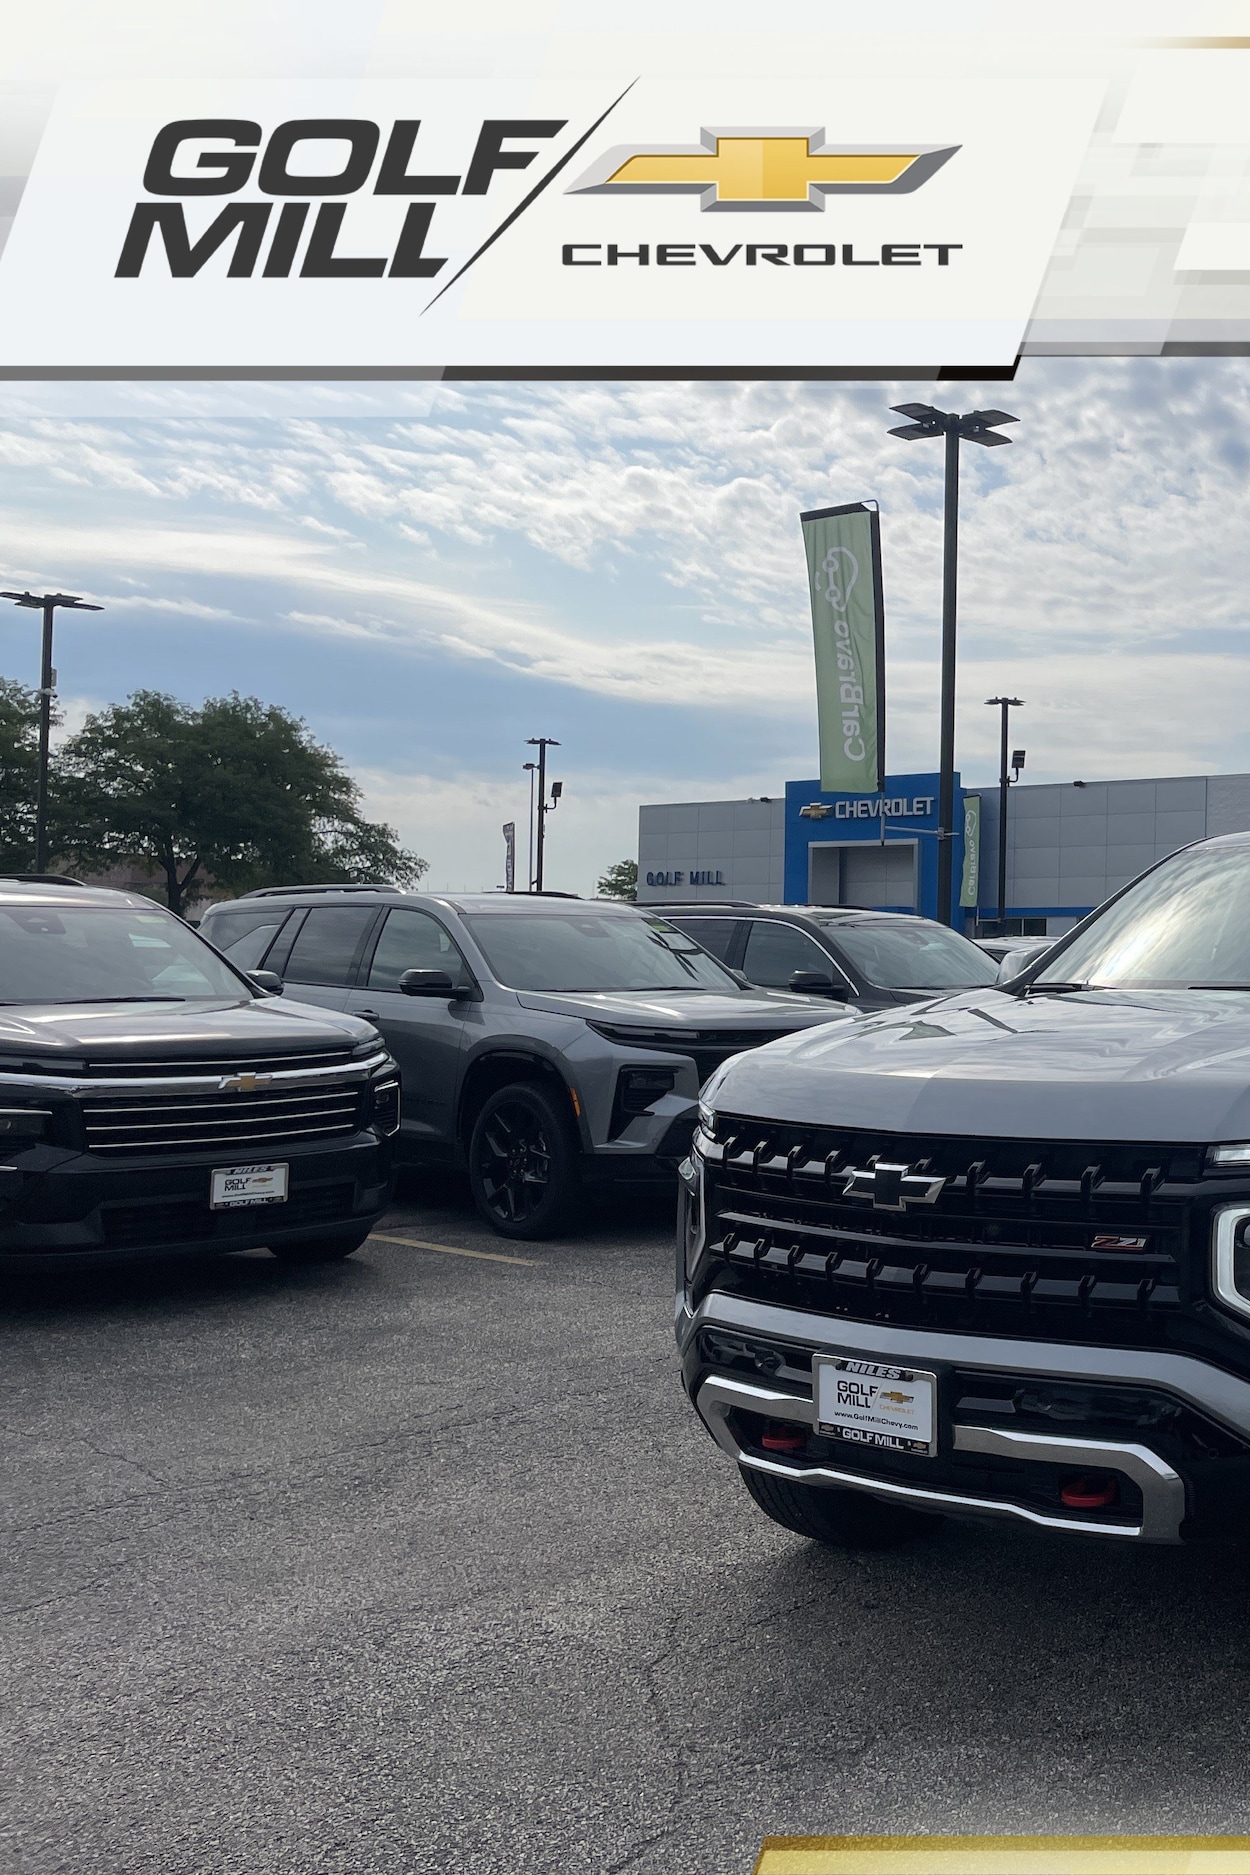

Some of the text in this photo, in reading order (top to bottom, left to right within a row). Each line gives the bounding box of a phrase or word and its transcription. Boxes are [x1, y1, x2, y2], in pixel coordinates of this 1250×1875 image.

[835, 797, 934, 819] CHEVROLET
[646, 870, 726, 886] GOLF MILL
[224, 1177, 252, 1186] GOLF
[224, 1183, 246, 1192] MILL
[845, 1362, 902, 1380] NILES
[837, 1380, 879, 1397] GOLF
[837, 1392, 872, 1409] MILL
[842, 1428, 905, 1450] GOLF MILL
